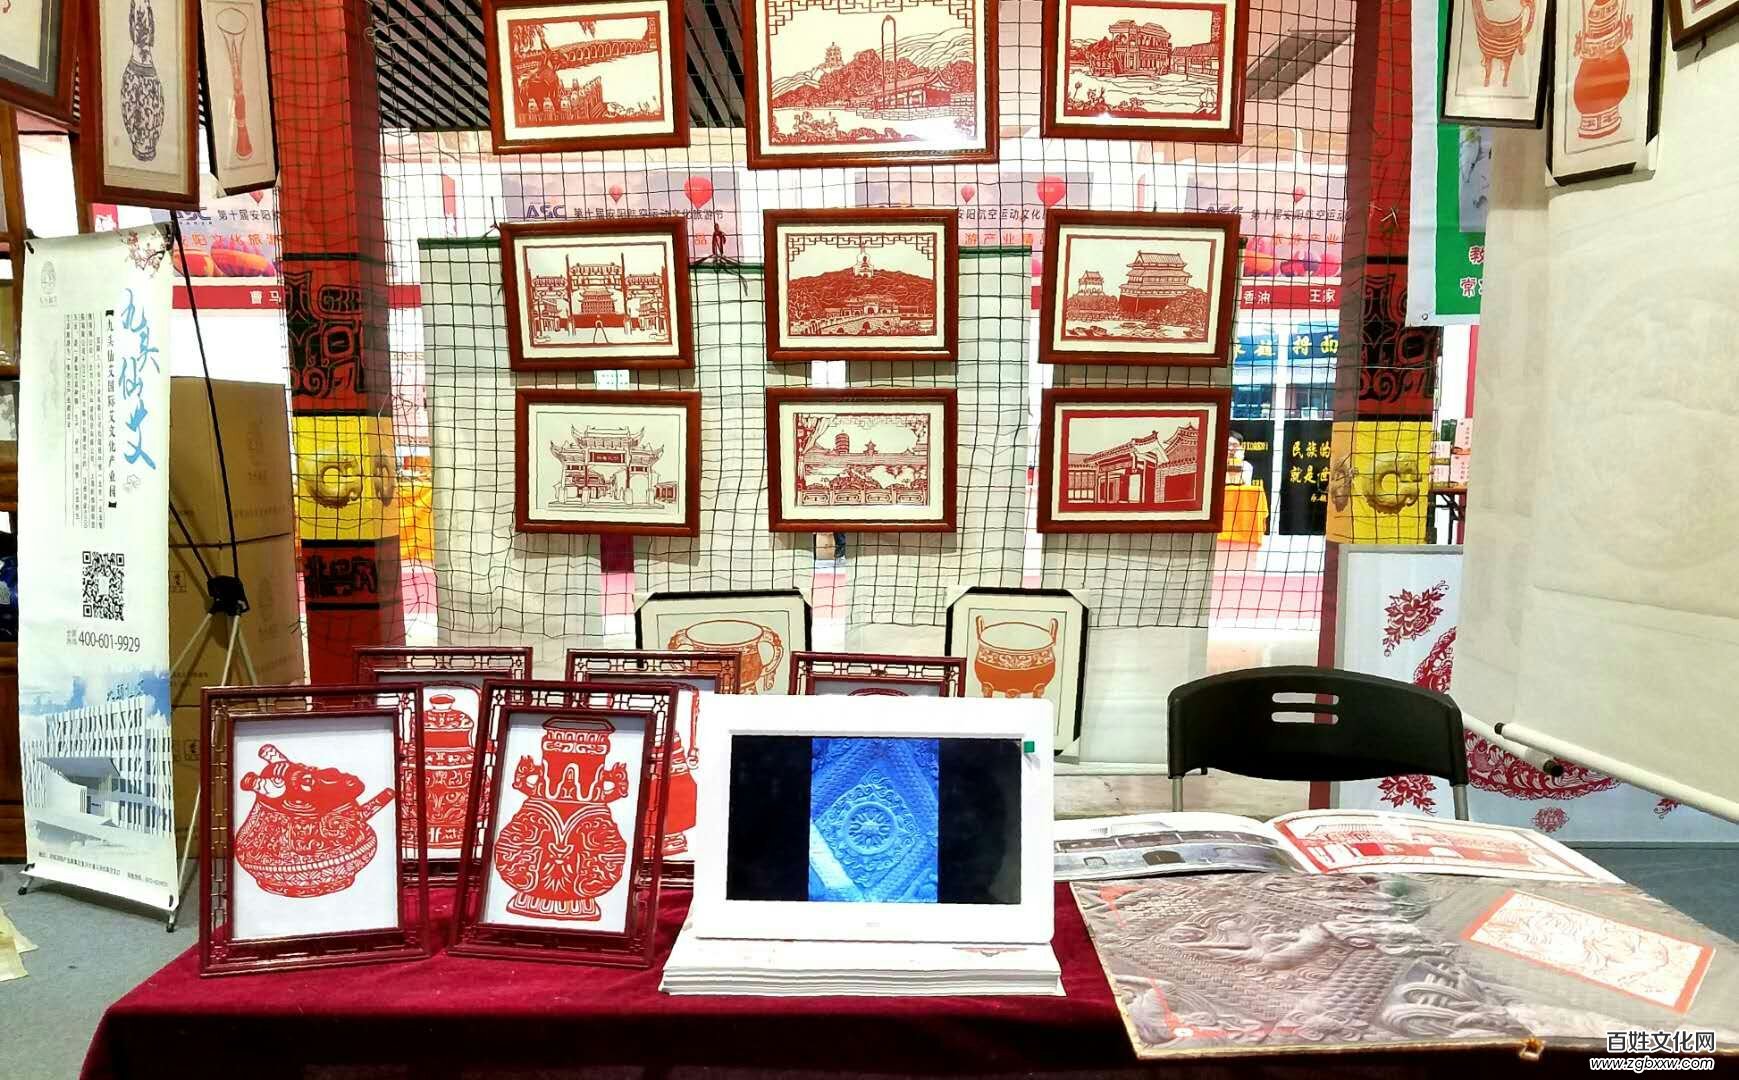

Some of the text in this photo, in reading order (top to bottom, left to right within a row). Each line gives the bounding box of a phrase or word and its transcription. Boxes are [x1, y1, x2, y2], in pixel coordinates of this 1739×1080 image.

[1243, 288, 1336, 304] 香油 王家
[1292, 441, 1331, 459] 民族的
[78, 631, 140, 653] 400-601-9929
